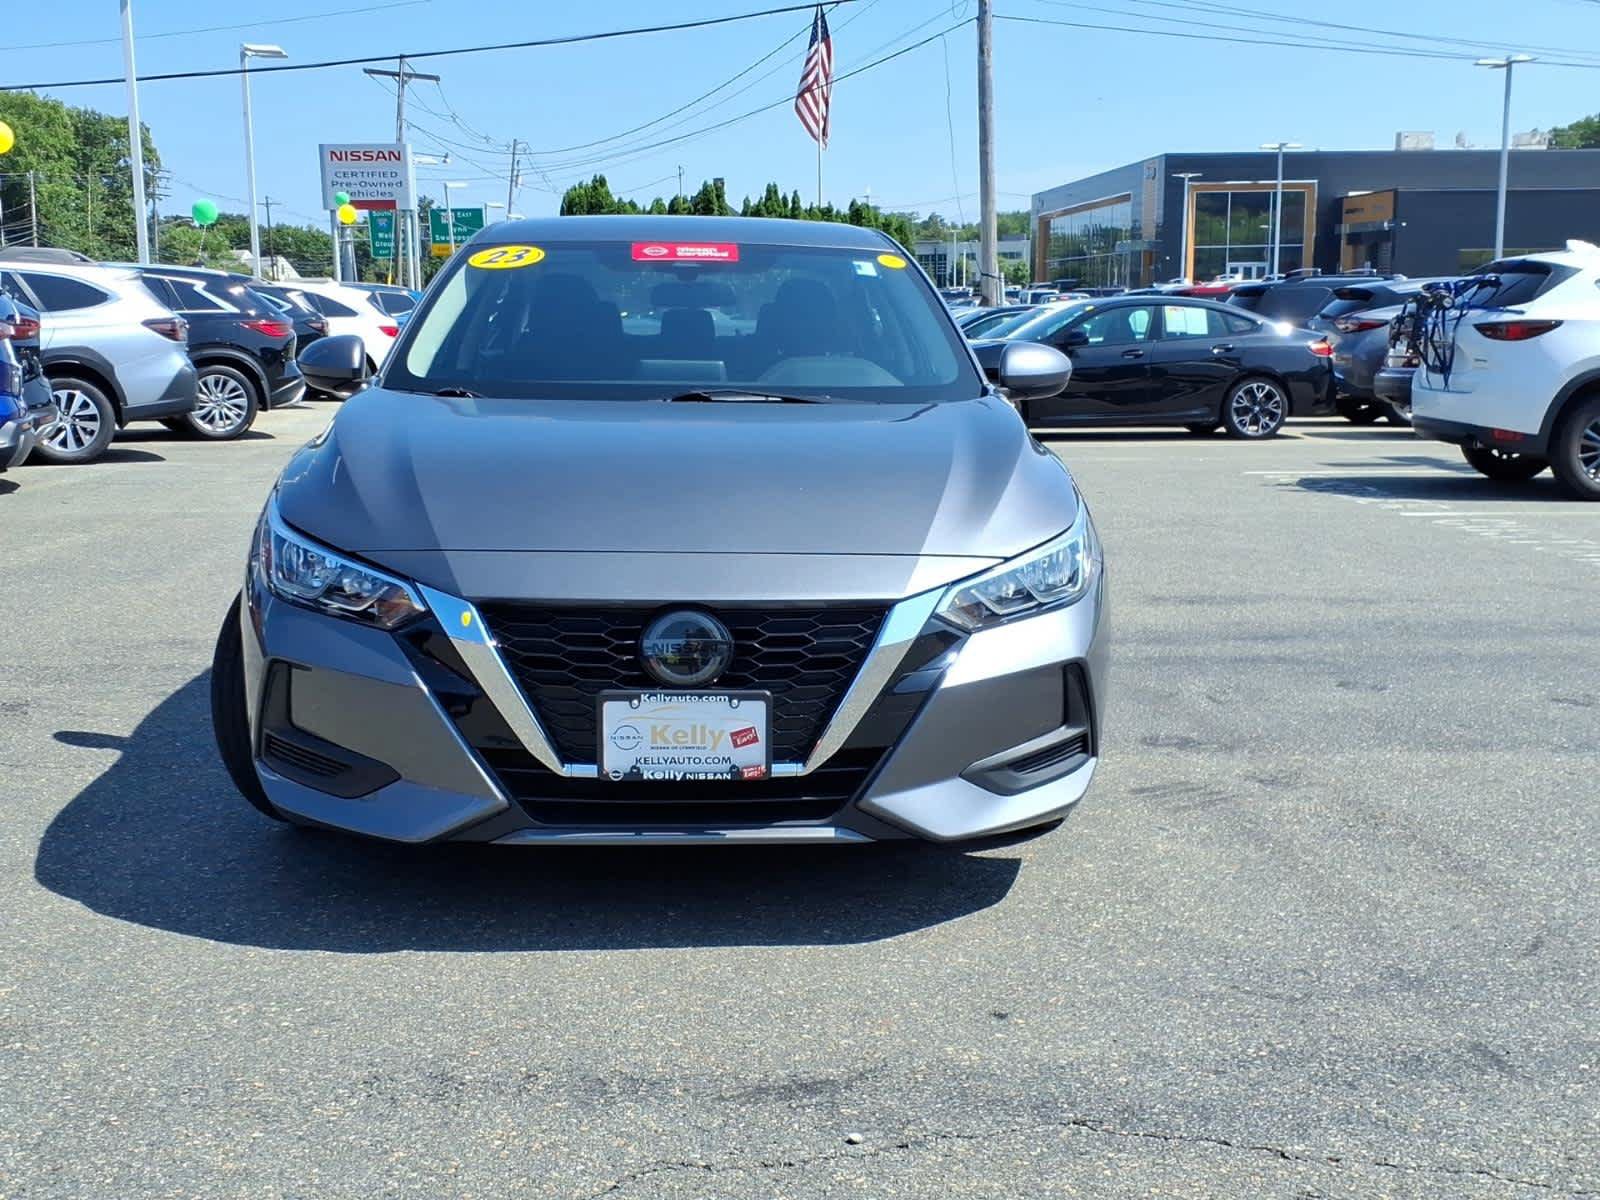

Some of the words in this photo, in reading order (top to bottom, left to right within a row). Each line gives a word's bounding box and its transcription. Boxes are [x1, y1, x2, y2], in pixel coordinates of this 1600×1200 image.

[329, 150, 402, 161] NISSAN
[334, 170, 398, 178] CERTIFIED
[331, 180, 403, 188] Pre-Owned
[480, 248, 532, 264] 23
[640, 693, 729, 703] Kellyauto.com
[650, 723, 726, 752] Kelly
[635, 756, 732, 766] KELLYAUTO.COM
[643, 768, 685, 781] Kelly
[686, 771, 731, 780] NISSAN
